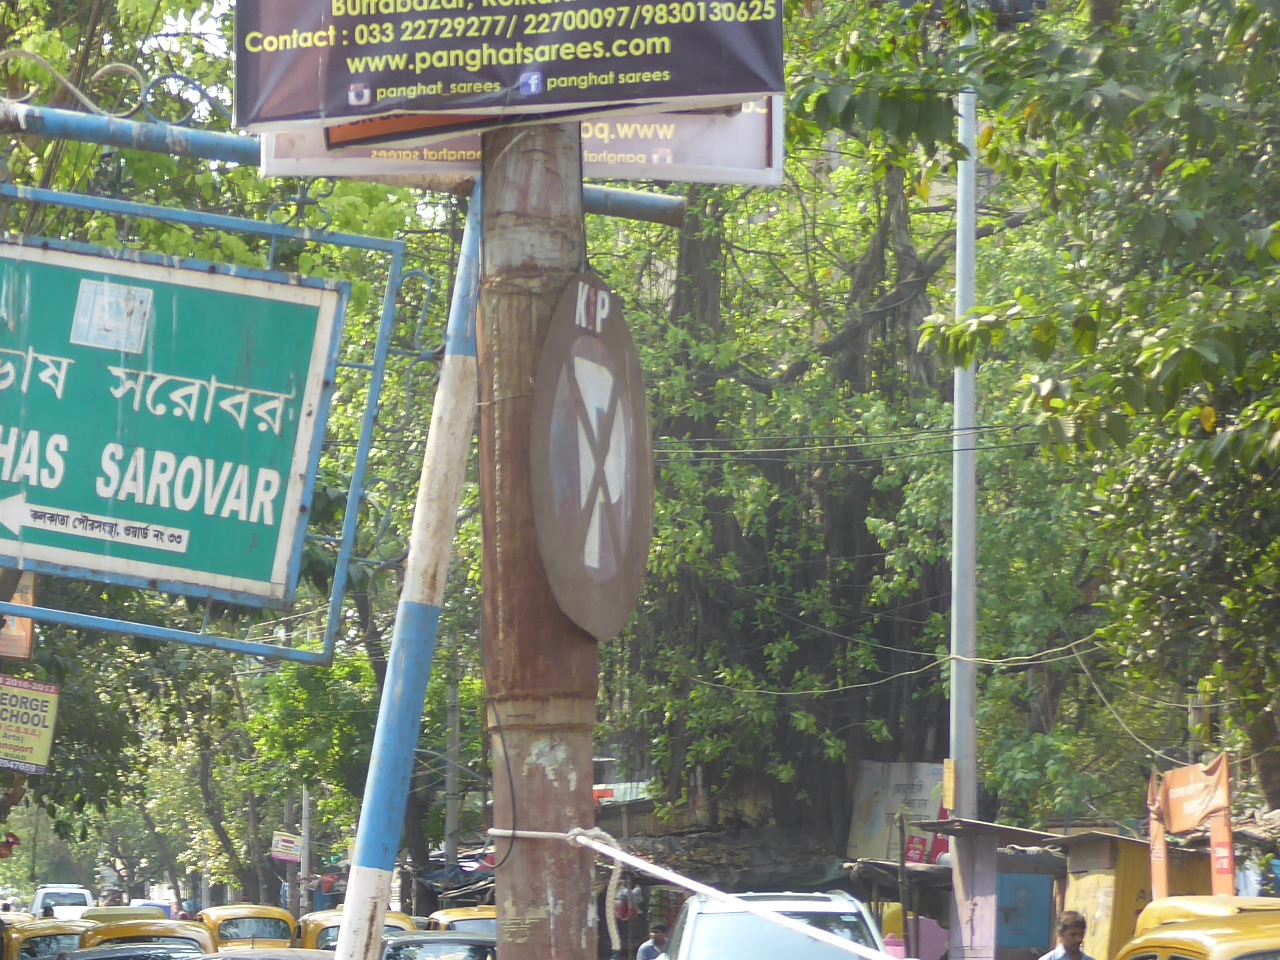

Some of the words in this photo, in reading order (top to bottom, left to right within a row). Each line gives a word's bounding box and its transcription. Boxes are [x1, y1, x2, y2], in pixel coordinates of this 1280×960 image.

[245, 25, 336, 53] Contact
[354, 26, 395, 46] 033
[346, 36, 671, 74] www.panghatsarees.com
[376, 79, 502, 101] panghat_sarees
[547, 70, 615, 91] panghat
[618, 68, 671, 84] sarees
[107, 365, 295, 436] সরোবর
[96, 443, 281, 525] SAROVAR
[30, 509, 70, 528] কলকাতা
